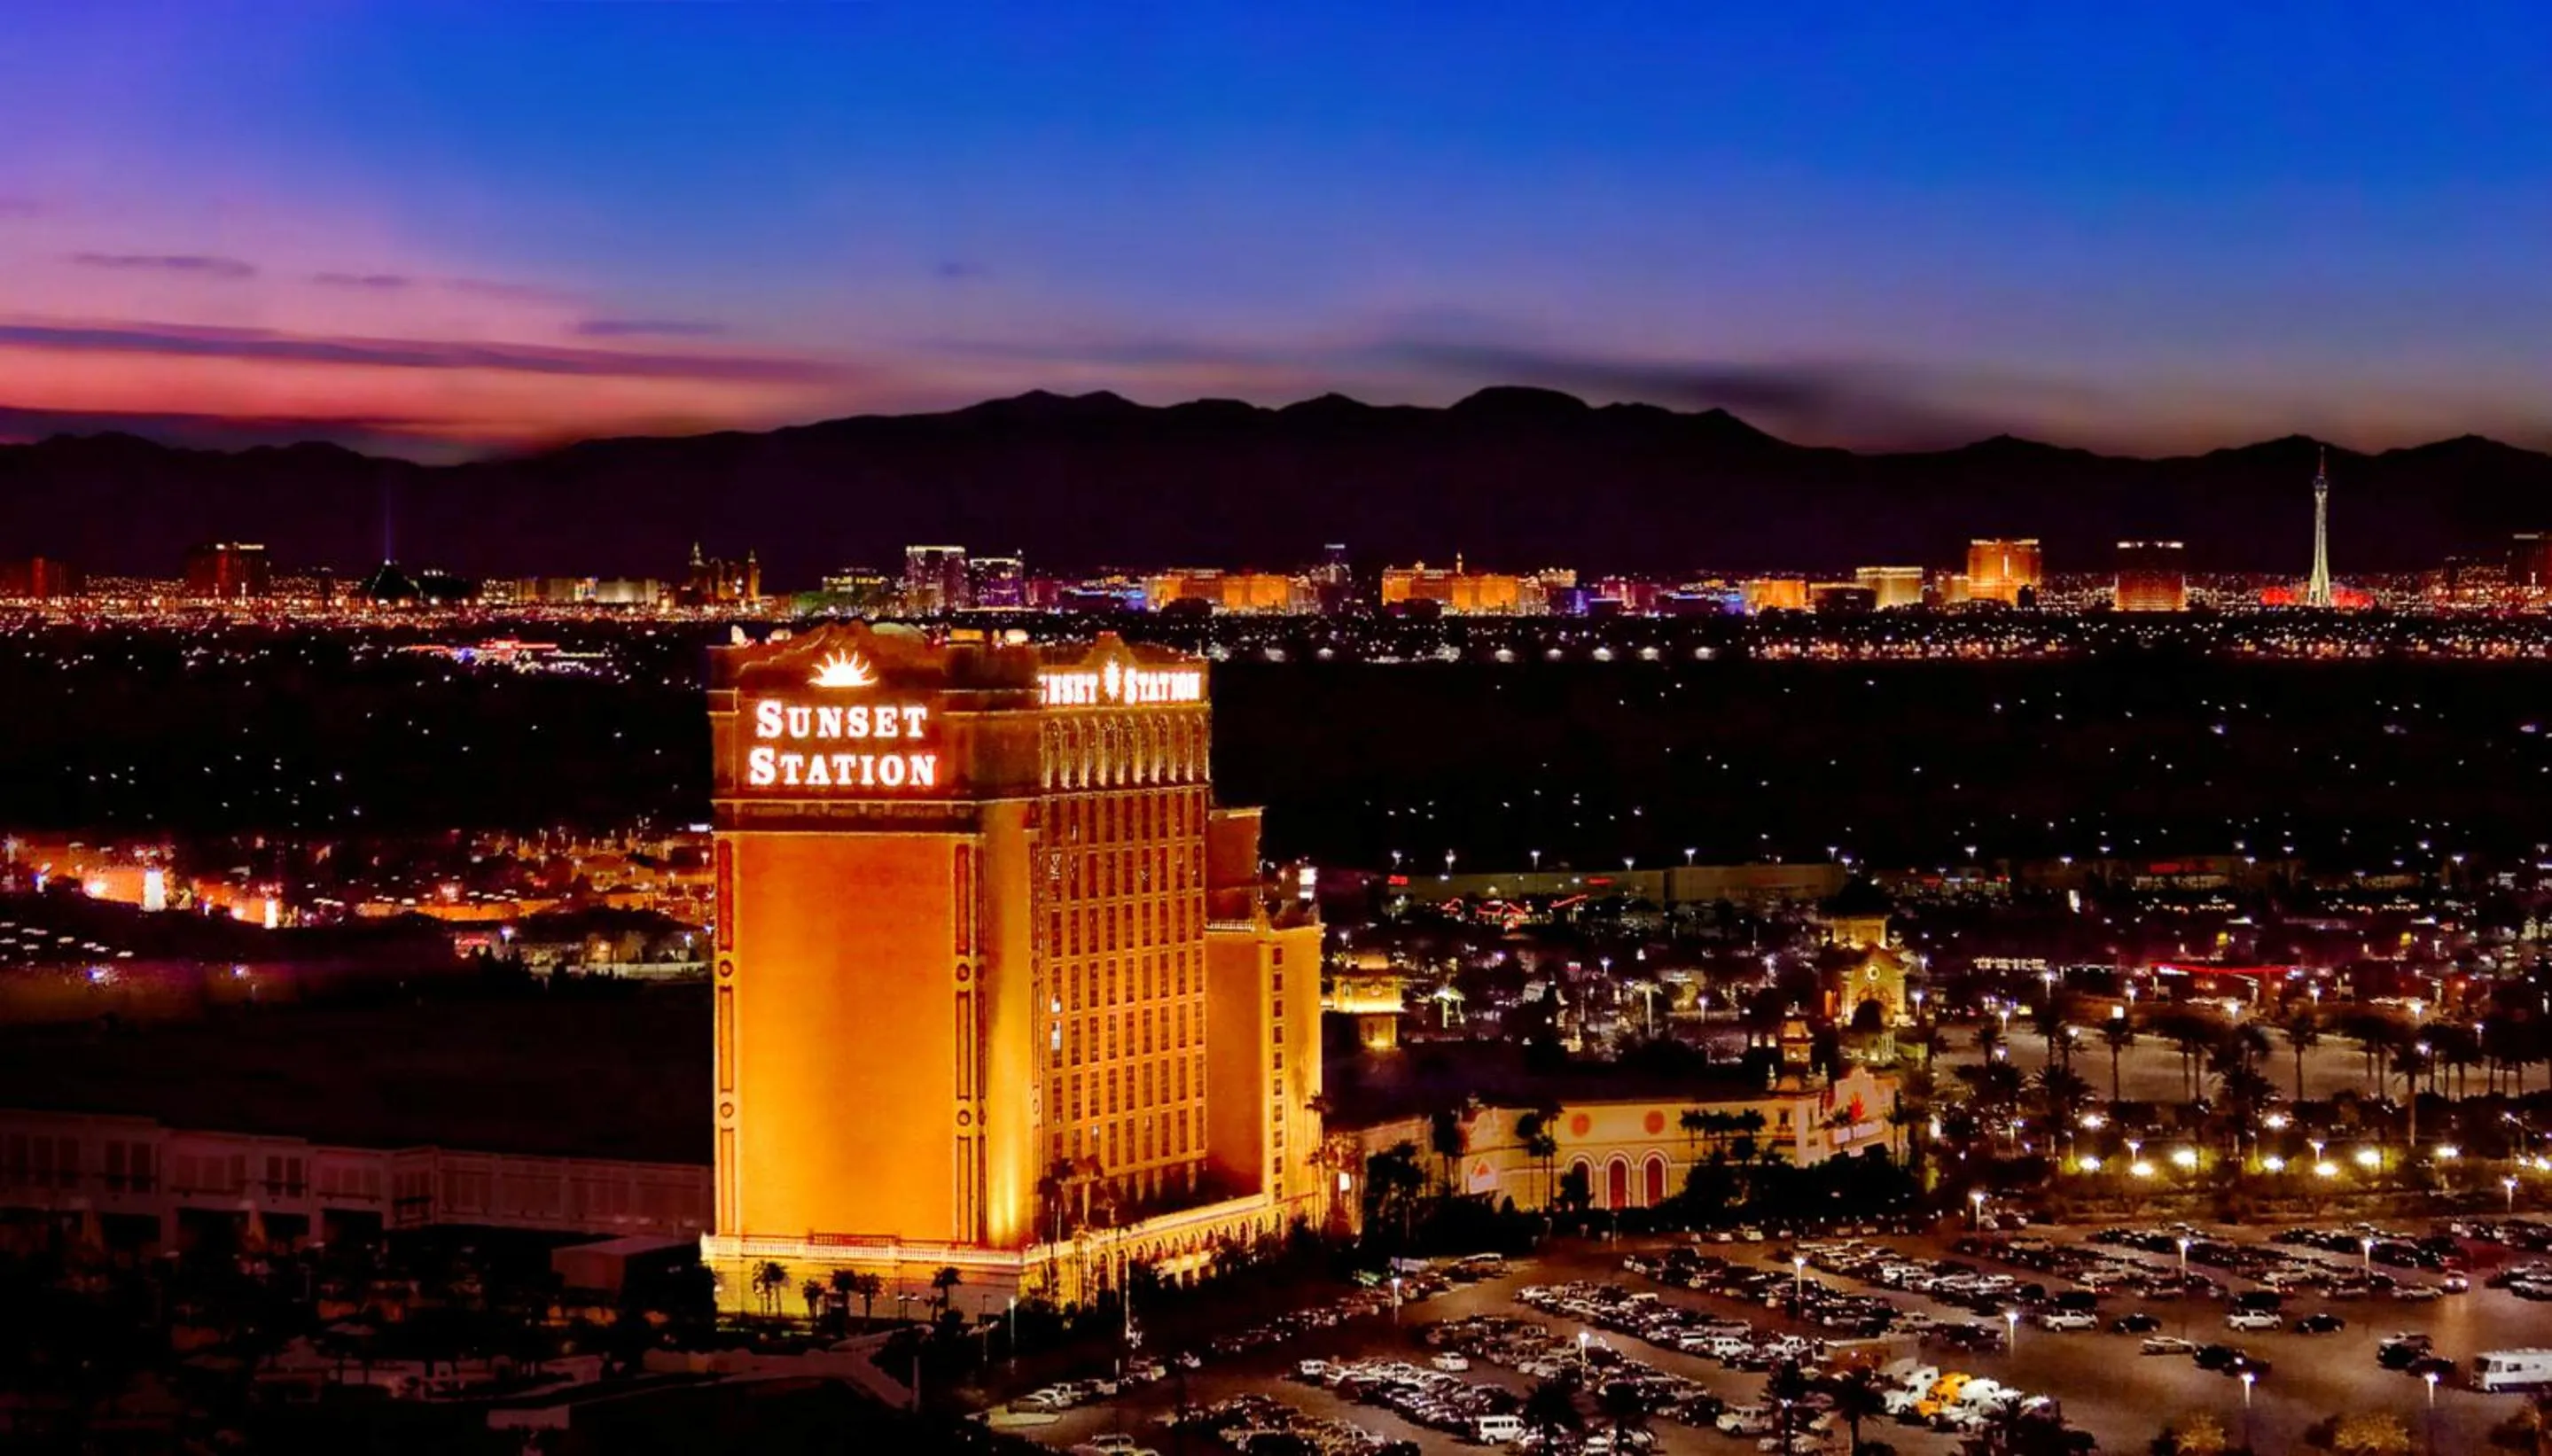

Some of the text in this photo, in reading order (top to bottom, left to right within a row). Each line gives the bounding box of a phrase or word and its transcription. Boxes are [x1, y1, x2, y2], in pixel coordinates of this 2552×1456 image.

[1123, 666, 1201, 705] STATION
[755, 698, 928, 738] SUNSET
[748, 745, 937, 786] STATION
